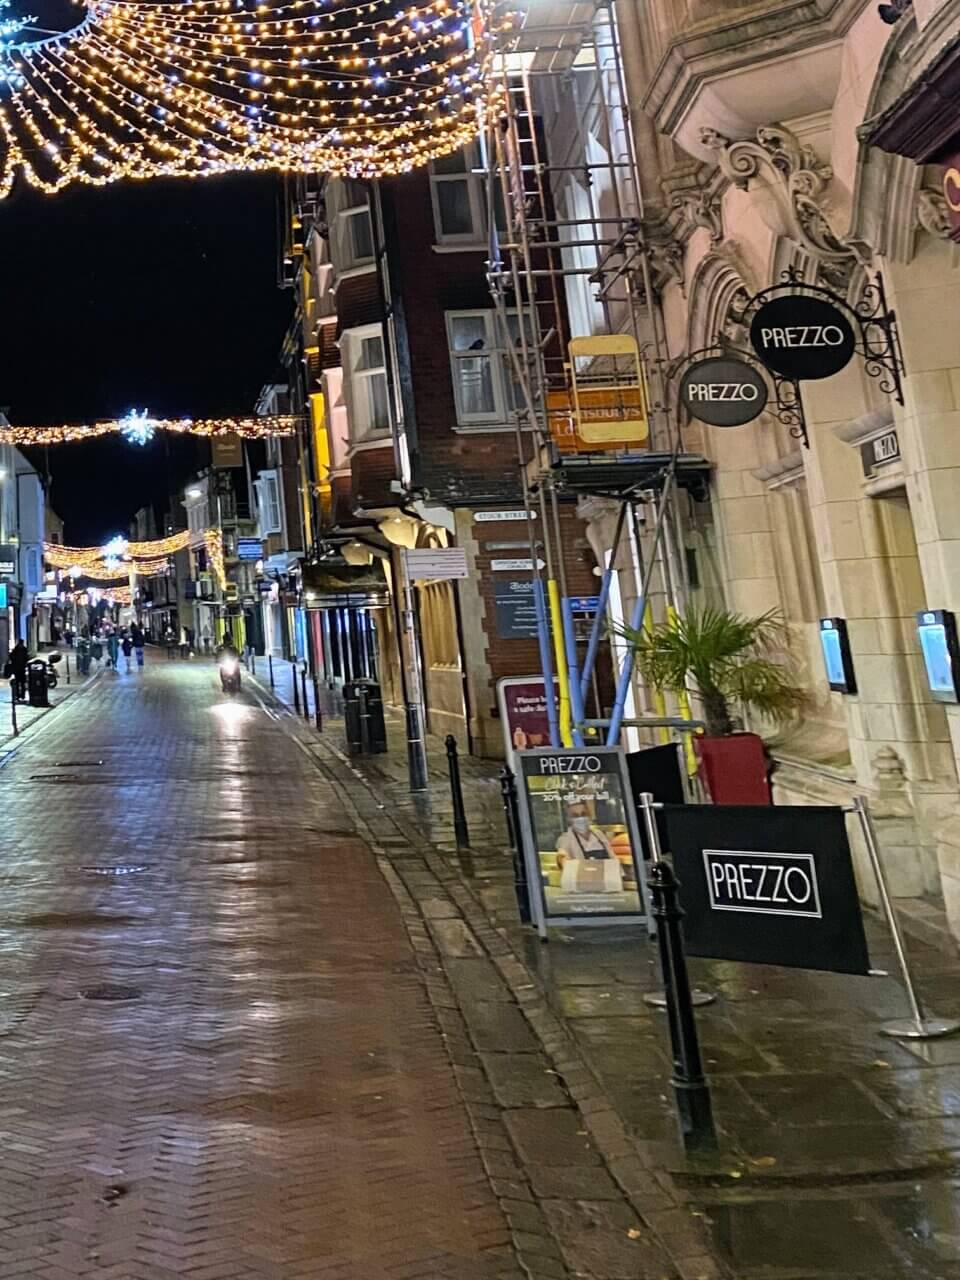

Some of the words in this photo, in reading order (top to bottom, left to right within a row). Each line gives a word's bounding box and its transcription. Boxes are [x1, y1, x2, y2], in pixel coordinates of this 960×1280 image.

[760, 325, 844, 348] PREZZO
[688, 383, 758, 401] PREZZO
[540, 756, 601, 773] PREZZO
[711, 862, 811, 904] PREZZO
